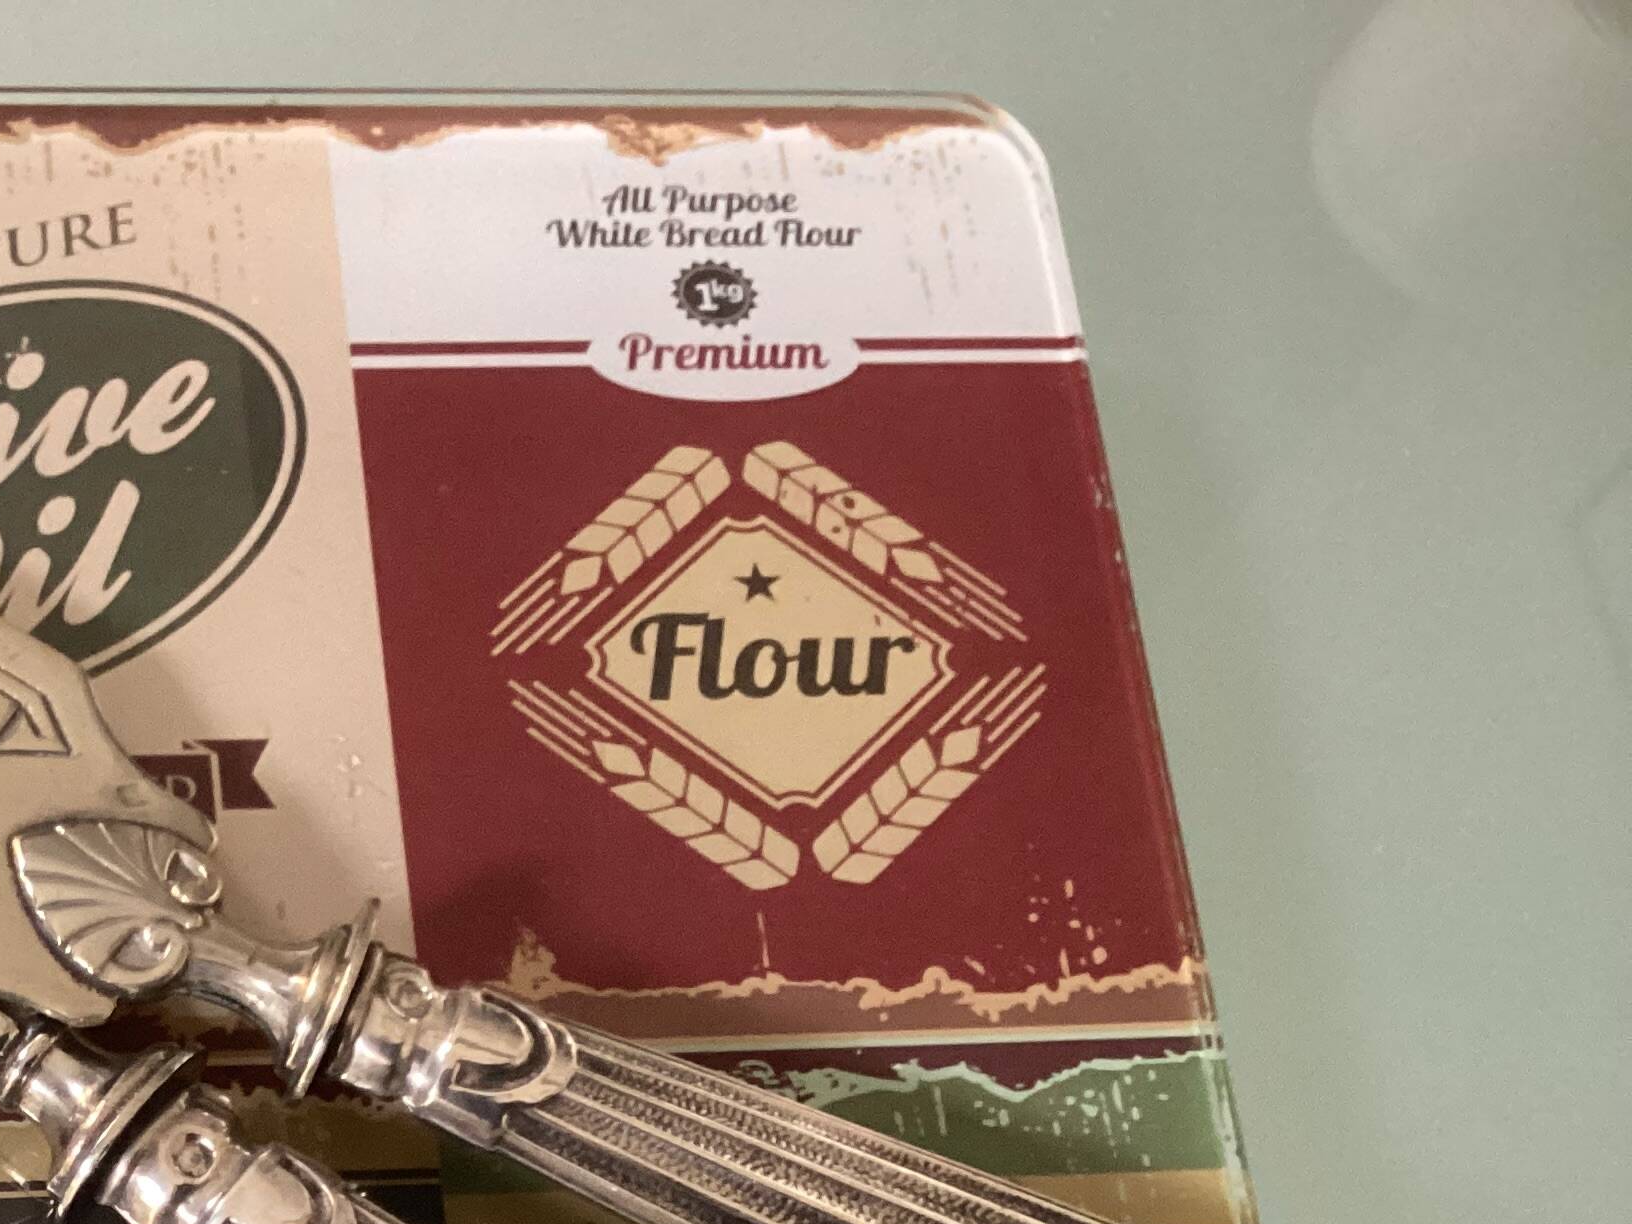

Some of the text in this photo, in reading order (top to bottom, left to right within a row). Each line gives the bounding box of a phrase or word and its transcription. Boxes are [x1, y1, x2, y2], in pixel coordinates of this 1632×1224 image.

[602, 183, 799, 221] All Purpose
[545, 218, 862, 249] White Bread Flour
[618, 332, 830, 372] Premium
[629, 611, 917, 701] Flour
